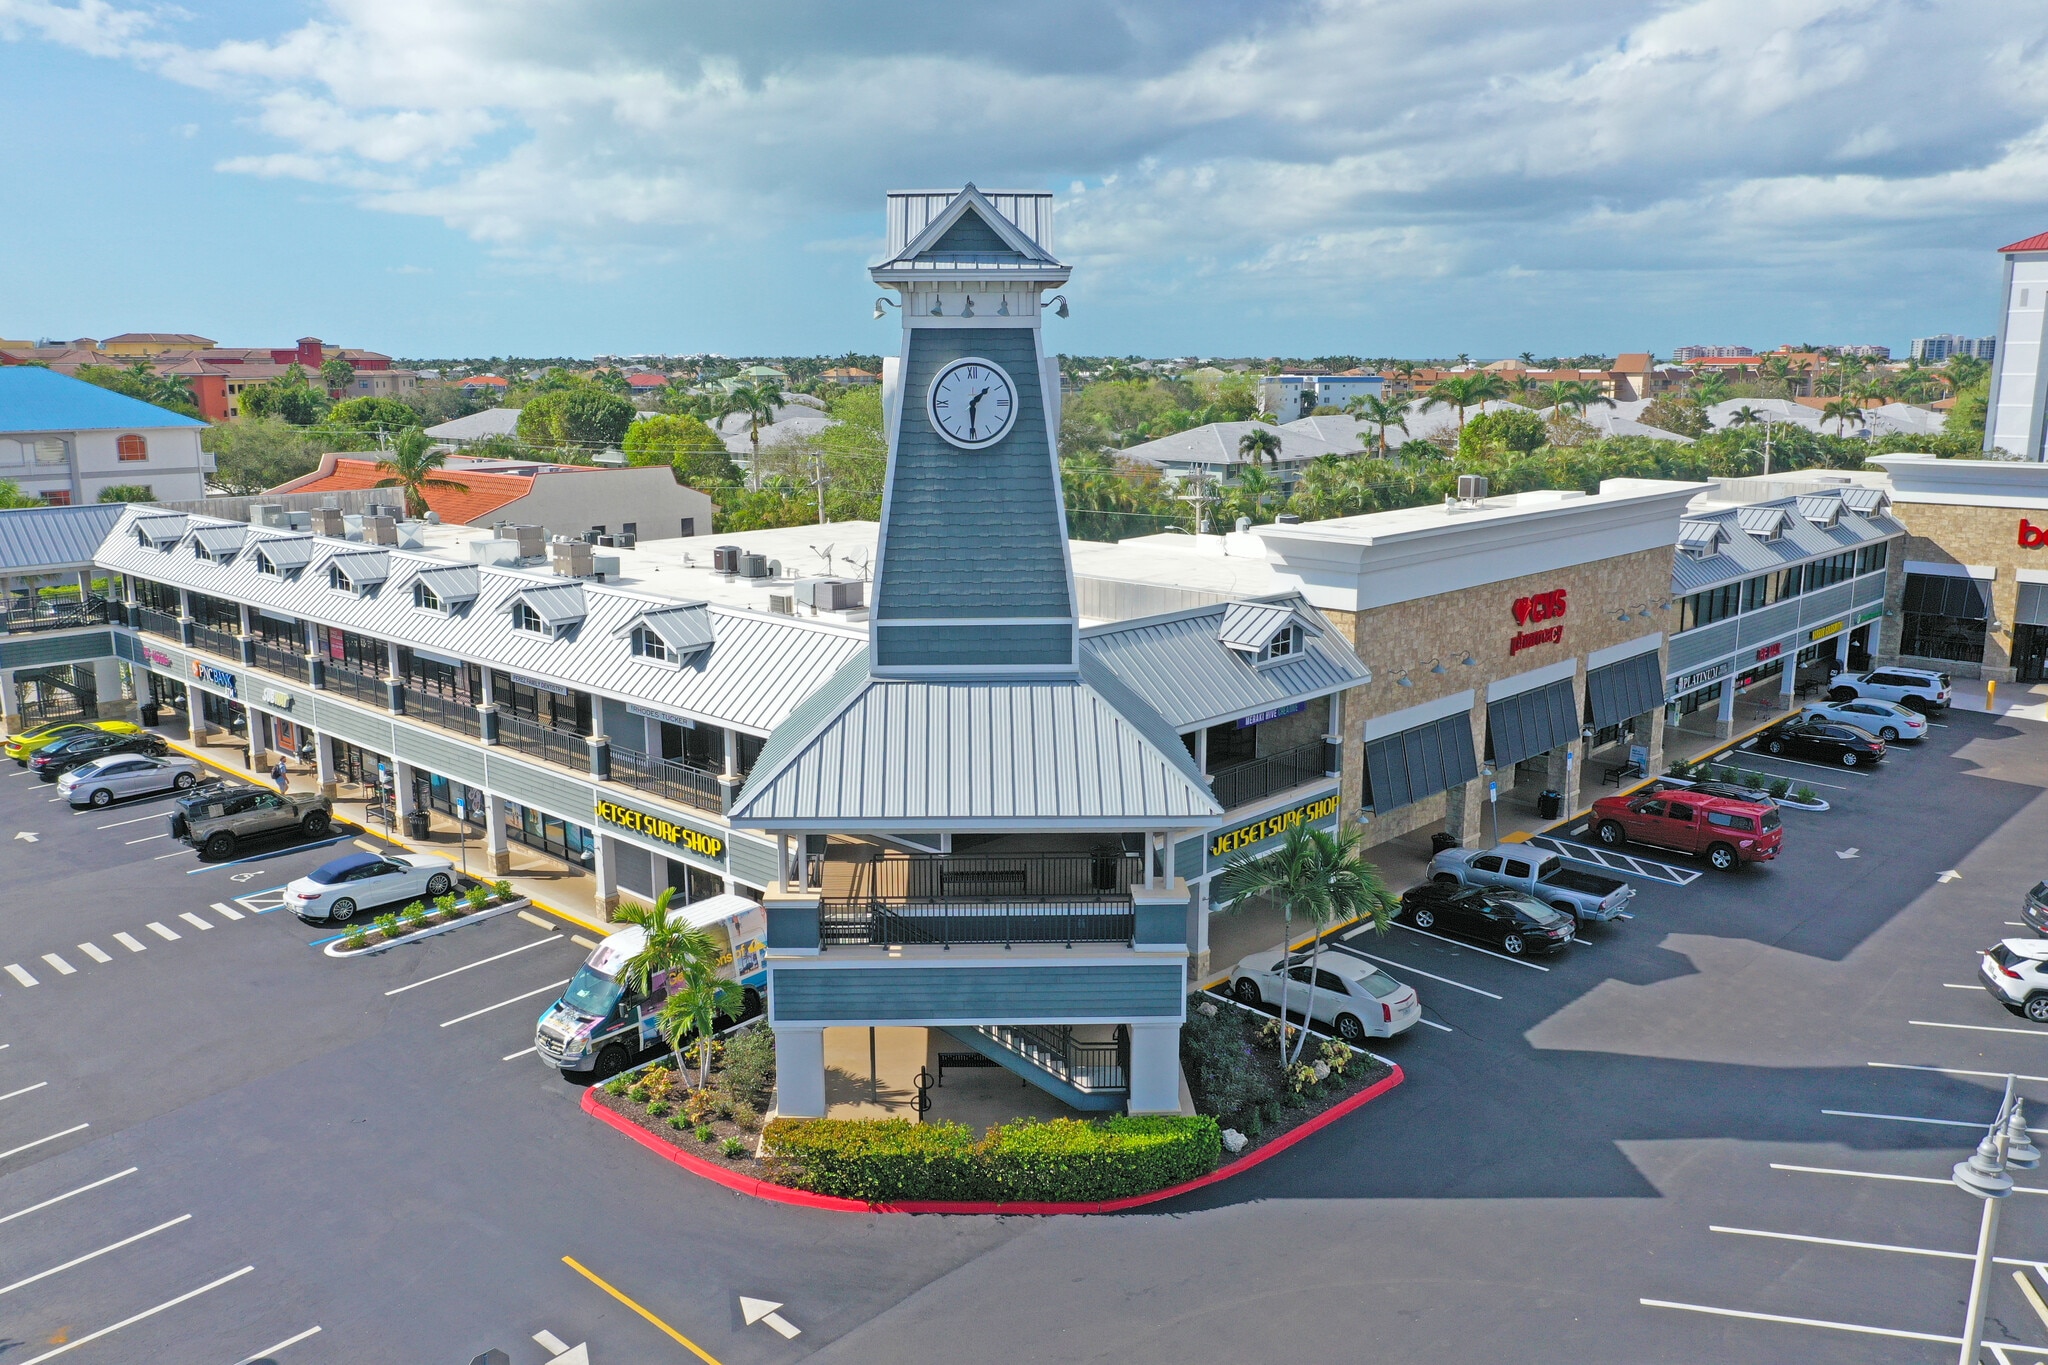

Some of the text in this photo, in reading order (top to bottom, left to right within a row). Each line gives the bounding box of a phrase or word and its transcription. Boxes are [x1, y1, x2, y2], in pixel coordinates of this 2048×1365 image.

[967, 366, 978, 380] XII
[2017, 518, 2048, 548] b
[1529, 588, 1567, 623] CVS
[199, 664, 233, 688] PNC BANK
[1683, 666, 1719, 689] PLATINUM
[633, 705, 688, 726] RHODES TUCKER
[594, 800, 721, 857] JETSET SURF SHOP
[1212, 795, 1341, 856] JETSET SURF SHOP
